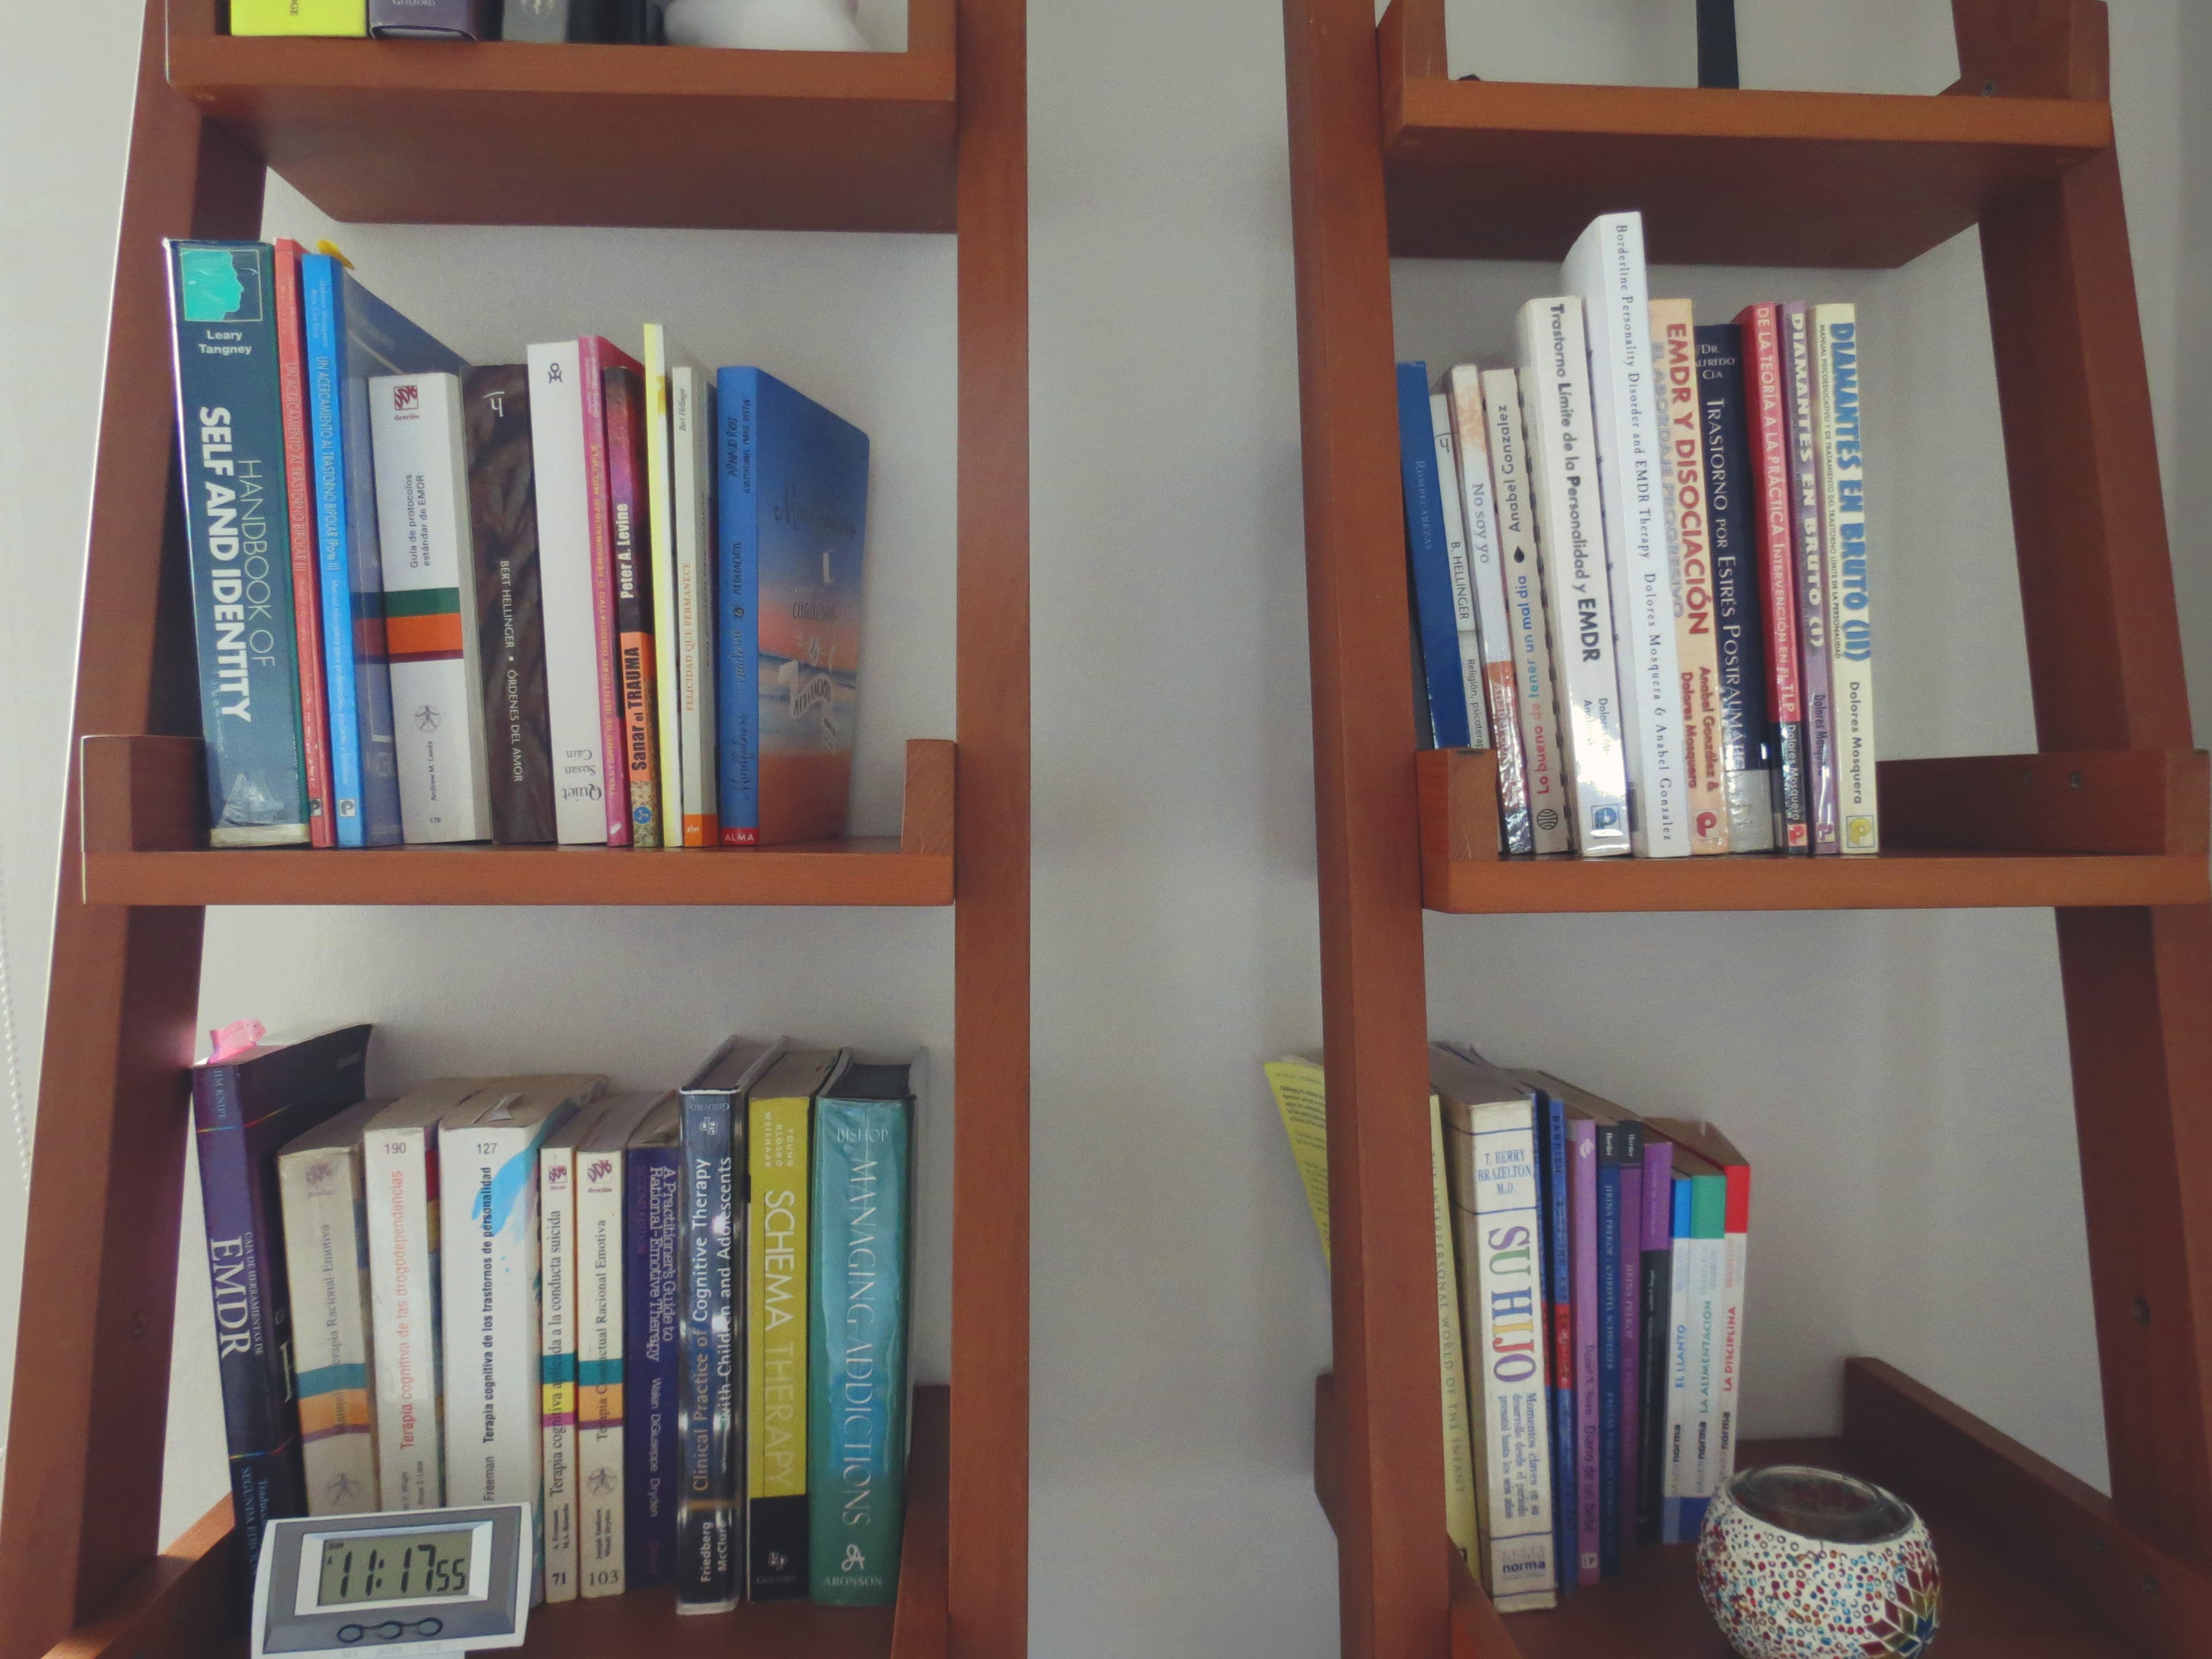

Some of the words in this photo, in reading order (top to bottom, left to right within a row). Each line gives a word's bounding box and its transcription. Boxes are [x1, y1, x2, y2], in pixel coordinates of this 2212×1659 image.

[1615, 224, 1632, 291] Borderline
[207, 330, 242, 342] Leary
[1618, 295, 1638, 368] Personality
[1757, 308, 1770, 326] DE
[198, 344, 252, 355] Tangney
[1549, 304, 1570, 378] Trastorno
[1758, 332, 1771, 350] LA
[1819, 324, 1827, 357] MANUAL
[316, 357, 329, 370] UN
[1666, 323, 1691, 403] EMDR
[317, 372, 332, 437] ACERCAMIENTO
[1556, 382, 1575, 428] Límite
[1627, 372, 1643, 427] Disorder
[1791, 315, 1812, 463] DIAMANTES
[1821, 358, 1830, 422] PSICOEDUCATIVO
[1830, 323, 1861, 469] DIAMANTES
[199, 406, 234, 476] SELF
[1494, 404, 1514, 475] Gonzalez
[1562, 431, 1578, 452] de
[1673, 411, 1694, 430] Y
[1763, 415, 1777, 427] A
[1764, 431, 1778, 451] LA
[1824, 430, 1831, 441] DE
[321, 439, 333, 449] AL
[1564, 455, 1581, 472] la
[1632, 432, 1645, 453] and
[321, 452, 336, 502] TRASTORNO
[1635, 460, 1649, 502] EMDR
[1801, 472, 1815, 505] EN
[1824, 442, 1834, 492] TRATAMIENTO
[403, 474, 418, 527] protocolos
[415, 474, 426, 506] EMDR
[1471, 483, 1485, 506] No
[1502, 478, 1521, 533] Anabel
[1838, 479, 1863, 512] EN
[205, 482, 239, 561] AND
[324, 503, 338, 537] BIPOLAR
[407, 529, 416, 543] de
[417, 508, 427, 521] de
[614, 502, 631, 545] Levine
[1471, 510, 1488, 539] soy
[1565, 475, 1591, 579] Personalidad
[1635, 507, 1653, 559] Therapy
[1827, 509, 1836, 554] TRASTORNO
[238, 460, 272, 620] HANDBOOK
[408, 544, 419, 569] Guía
[418, 524, 431, 567] estándar
[618, 548, 632, 561] A.
[1450, 540, 1462, 552] B.
[1474, 543, 1491, 565] yo
[1675, 438, 1713, 635] DISOCIACIÓN
[499, 560, 511, 586] BERT
[618, 563, 634, 599] Peter
[1804, 516, 1821, 605] BRUTO
[1839, 522, 1869, 611] BRUTO
[681, 561, 692, 626] PERMANECE
[1452, 555, 1469, 620] HELLINGER
[1571, 583, 1586, 593] y
[1643, 572, 1659, 627] Dolores
[1831, 580, 1838, 590] DE
[1831, 591, 1839, 601] LA
[501, 589, 515, 649] HELLINGER
[1517, 601, 1532, 631] mal
[1577, 597, 1601, 663] EMDR
[1832, 602, 1841, 658] PERSONALIDAD
[212, 569, 252, 722] IDENTITY
[249, 629, 275, 666] OF
[683, 628, 695, 652] QUE
[1524, 633, 1535, 653] un
[1841, 619, 1872, 661] (II)
[623, 646, 642, 709] TRAUMA
[684, 654, 695, 711] FELICIDAD
[1524, 659, 1540, 698] tener
[1644, 634, 1664, 699] Mosquera
[506, 668, 521, 722] ÓRDENES
[1681, 672, 1695, 721] Dolores
[1699, 666, 1714, 712] Anabel
[1780, 683, 1795, 713] TLP
[1850, 681, 1861, 733] Dolores
[633, 711, 644, 722] el
[1527, 702, 1541, 721] de
[1653, 706, 1665, 717] &
[510, 724, 521, 745] DEL
[628, 724, 647, 771] Sanar
[1530, 724, 1547, 772] bueno
[1654, 723, 1669, 770] Anabel
[511, 747, 524, 782] AMOR
[1683, 724, 1699, 789] Mosquera
[1849, 737, 1862, 804] Mosquera
[562, 783, 601, 801] Quiet
[1536, 775, 1551, 794] Lo
[1658, 777, 1675, 840] Gonzalez
[385, 1142, 406, 1154] 190
[477, 1142, 497, 1154] 127
[1484, 1153, 1493, 1166] T.
[1495, 1149, 1526, 1164] BERRY
[663, 1166, 675, 1178] A
[1478, 1164, 1532, 1182] BRAZELTON
[1496, 1181, 1516, 1195] M.D.
[480, 1166, 494, 1237] personalidad
[692, 1158, 711, 1230] Therapy
[388, 1169, 410, 1296] drogodependencias
[481, 1240, 493, 1254] de
[548, 1210, 562, 1253] suicida
[594, 1219, 607, 1268] Emotiva
[648, 1166, 662, 1297] Rational-Emotive
[662, 1182, 676, 1279] Practitioner's
[846, 1159, 877, 1324] MANAGING
[1487, 1225, 1532, 1277] SU
[692, 1237, 711, 1321] Cognitive
[717, 1267, 730, 1297] and
[764, 1190, 794, 1331] SCHEMA
[209, 1235, 252, 1359] EMDR
[482, 1257, 493, 1312] trastornos
[548, 1255, 562, 1310] conducta
[596, 1273, 607, 1323] Racional
[662, 1281, 675, 1324] Guide
[395, 1299, 408, 1318] las
[395, 1322, 408, 1337] de
[482, 1315, 493, 1331] los
[548, 1313, 562, 1325] la
[482, 1334, 493, 1347] de
[646, 1299, 661, 1362] Therapy
[662, 1327, 673, 1342] to
[693, 1328, 707, 1346] of
[1490, 1286, 1536, 1384] HIJO
[1675, 1324, 1686, 1372] LLANTO
[1724, 1305, 1736, 1374] DISCIPLINA
[396, 1341, 415, 1399] cognitiva
[482, 1351, 495, 1400] cognitiva
[693, 1353, 708, 1421] Practice
[1675, 1375, 1684, 1388] EL
[1723, 1376, 1732, 1392] LA
[398, 1403, 418, 1449] Terapia
[482, 1403, 497, 1443] Terapia
[548, 1391, 566, 1449] cognitiva
[596, 1398, 609, 1441] Terapia
[764, 1341, 793, 1487] THERAPY
[1525, 1393, 1539, 1448] Momentos
[1699, 1398, 1709, 1414] LA
[842, 1336, 874, 1526] ADDICTIONS
[1672, 1423, 1681, 1463] norma
[1696, 1420, 1707, 1460] norma
[1719, 1411, 1731, 1450] norma
[549, 1451, 566, 1495] Terapia
[693, 1428, 709, 1491] Clinical
[1528, 1452, 1540, 1486] claves
[340, 1544, 437, 1599] 11:17
[436, 1558, 466, 1592] 55
[700, 1522, 713, 1581] Friedberg
[1502, 1561, 1546, 1573] norma
[552, 1572, 566, 1586] 71
[589, 1570, 619, 1586] 103
